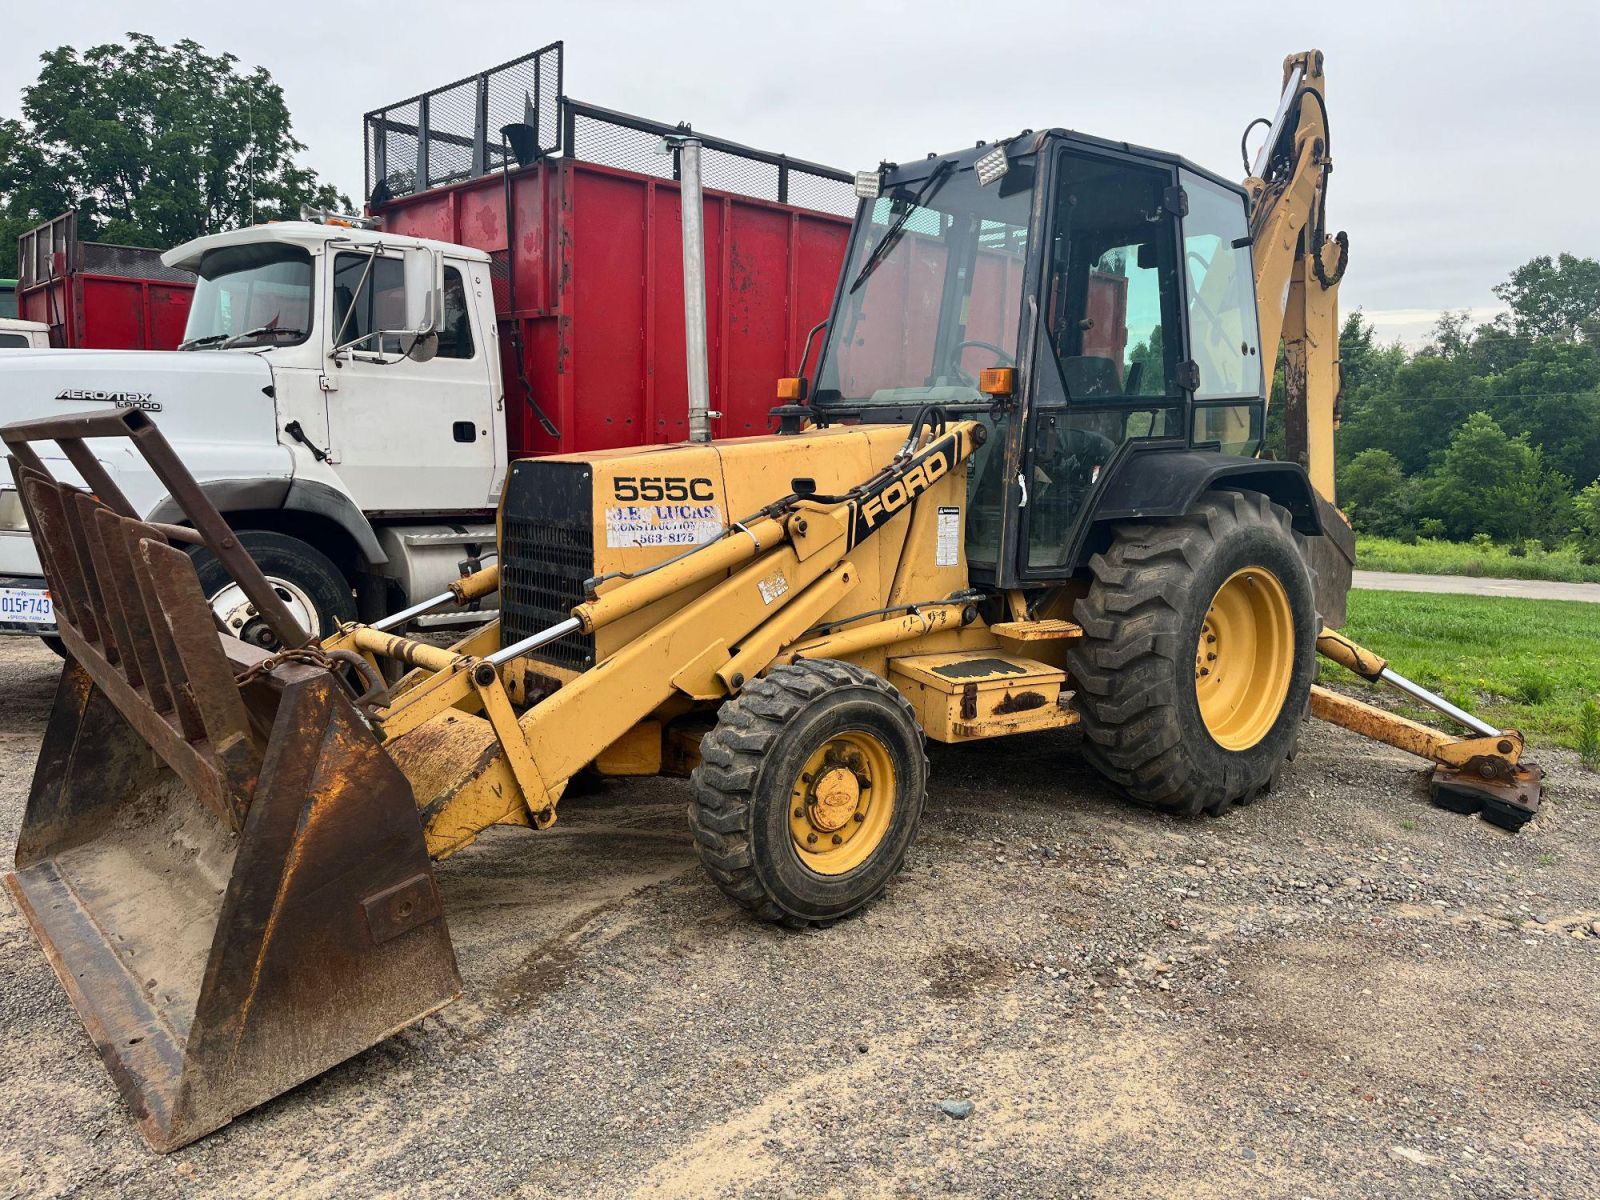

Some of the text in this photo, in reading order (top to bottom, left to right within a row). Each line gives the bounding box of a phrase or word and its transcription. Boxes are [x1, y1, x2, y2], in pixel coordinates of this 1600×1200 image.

[612, 476, 714, 502] 555C
[861, 450, 948, 529] FORD
[654, 505, 714, 520] LUCAS
[640, 533, 695, 544] 563-8175
[2, 597, 50, 614] 015F743
